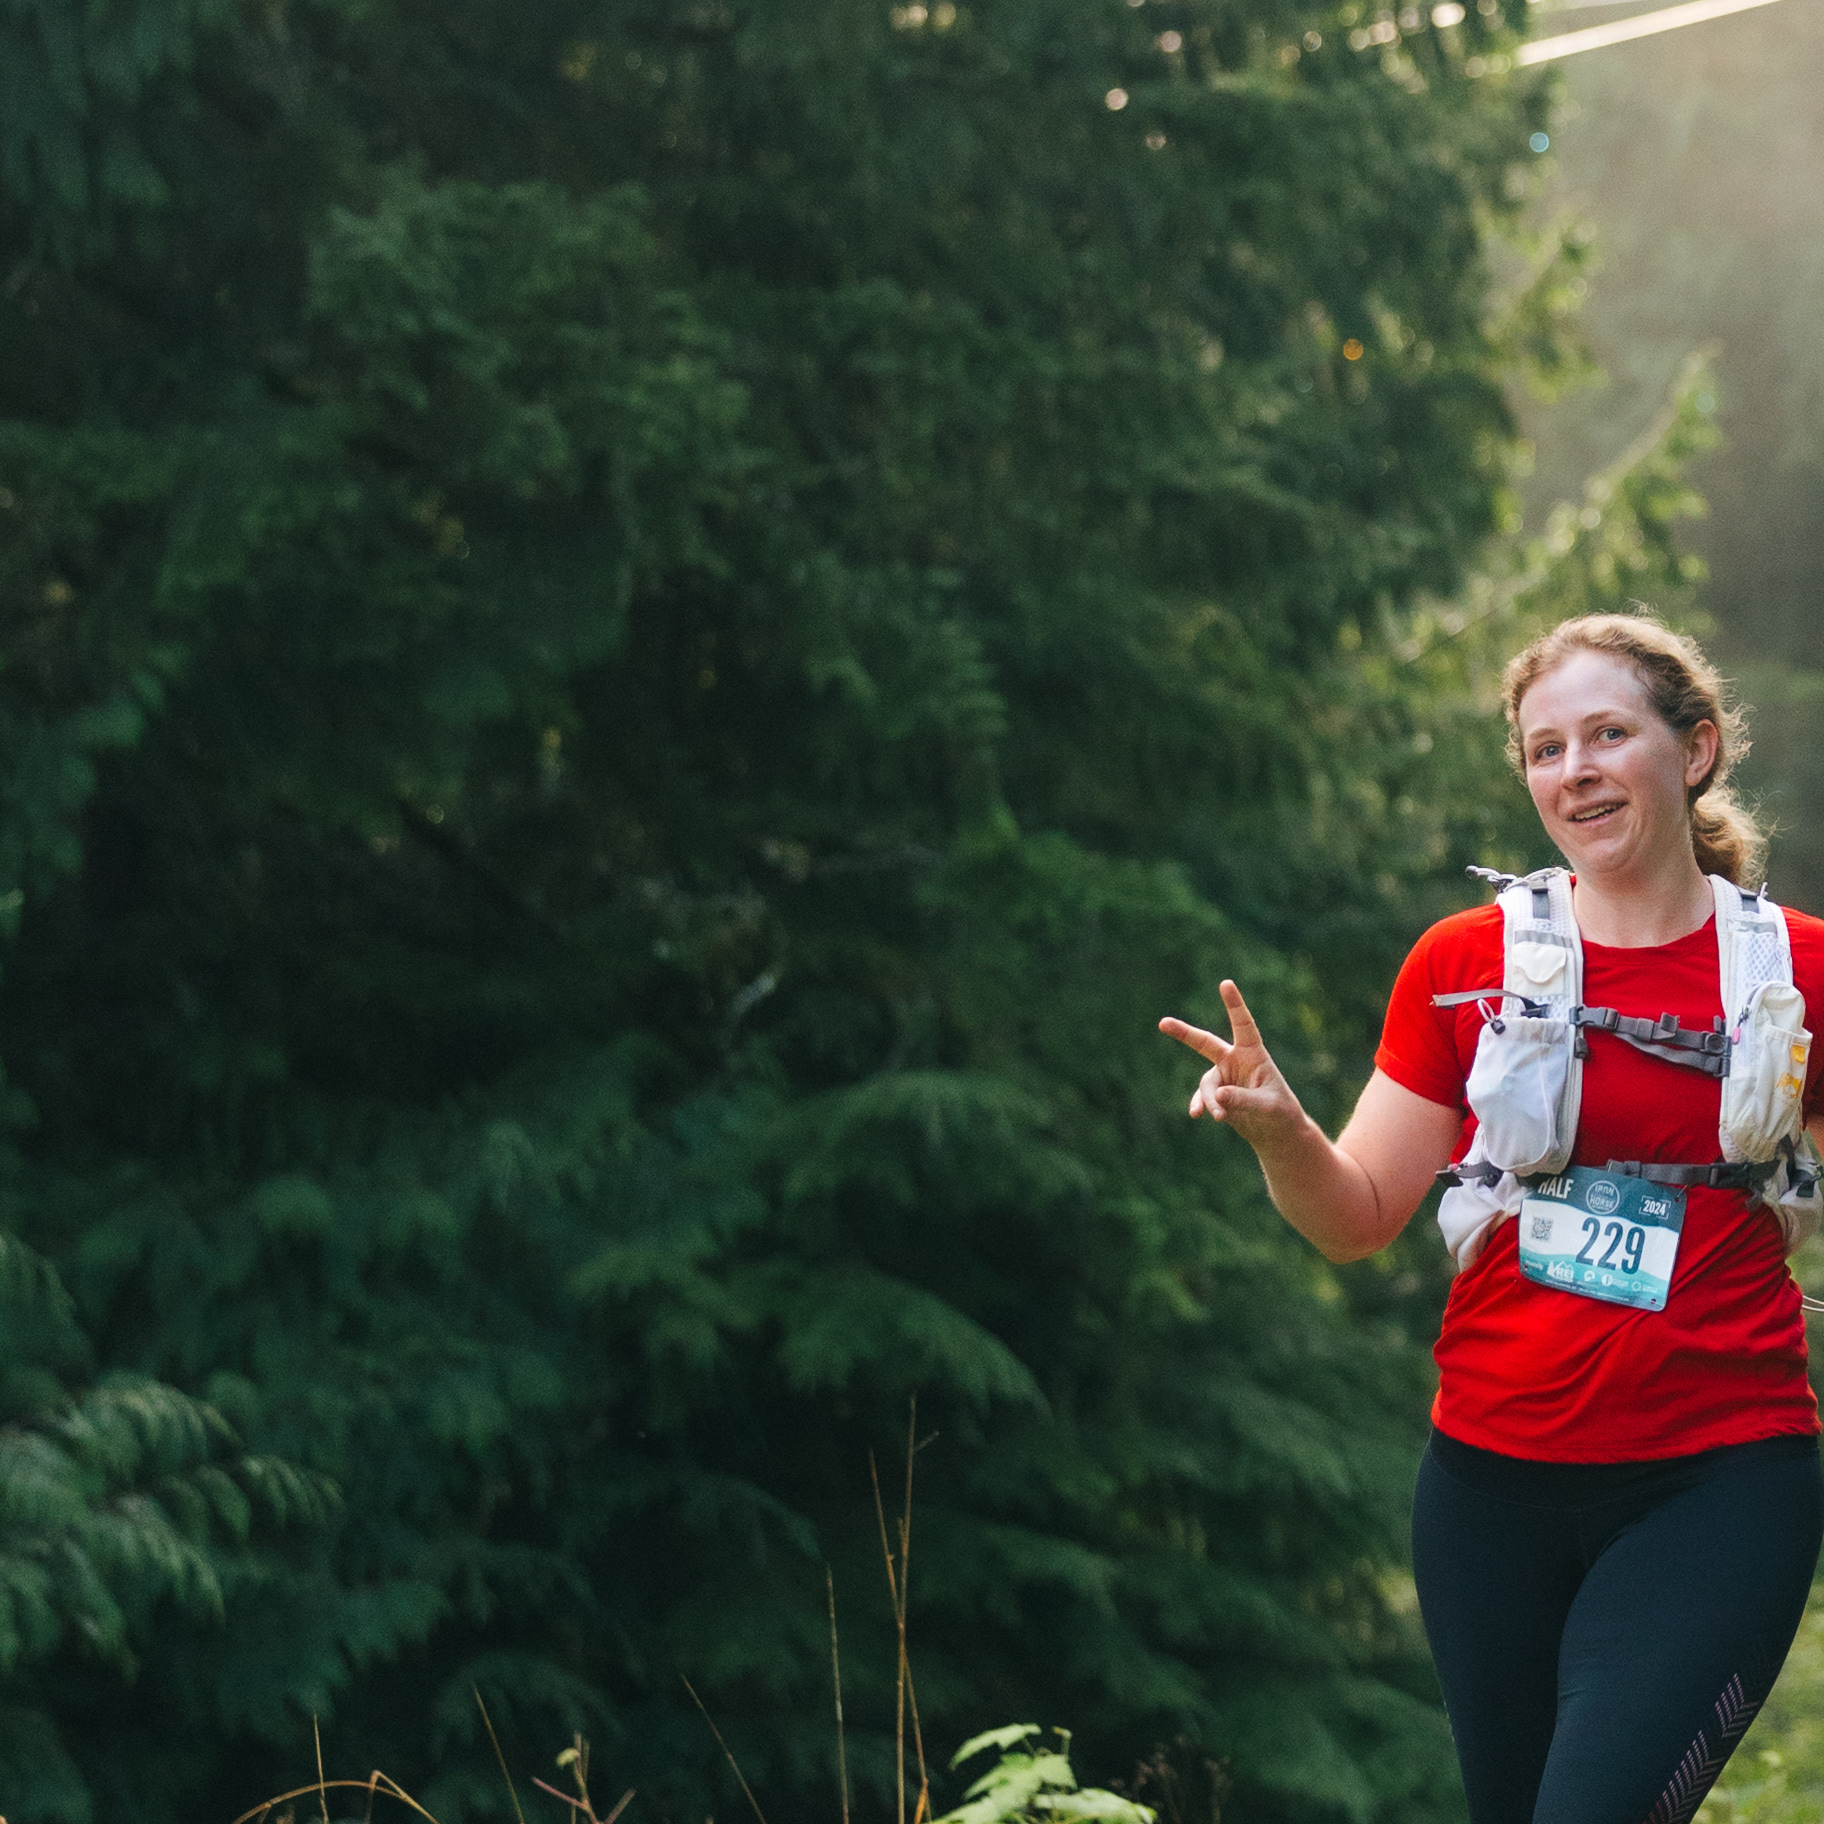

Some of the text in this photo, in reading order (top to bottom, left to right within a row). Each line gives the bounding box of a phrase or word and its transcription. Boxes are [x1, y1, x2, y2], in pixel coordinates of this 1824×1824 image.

[1538, 1177, 1574, 1199] HALF
[1644, 1200, 1666, 1215] 2024
[1576, 1217, 1646, 1274] 229
[1556, 1267, 1574, 1279] REI
